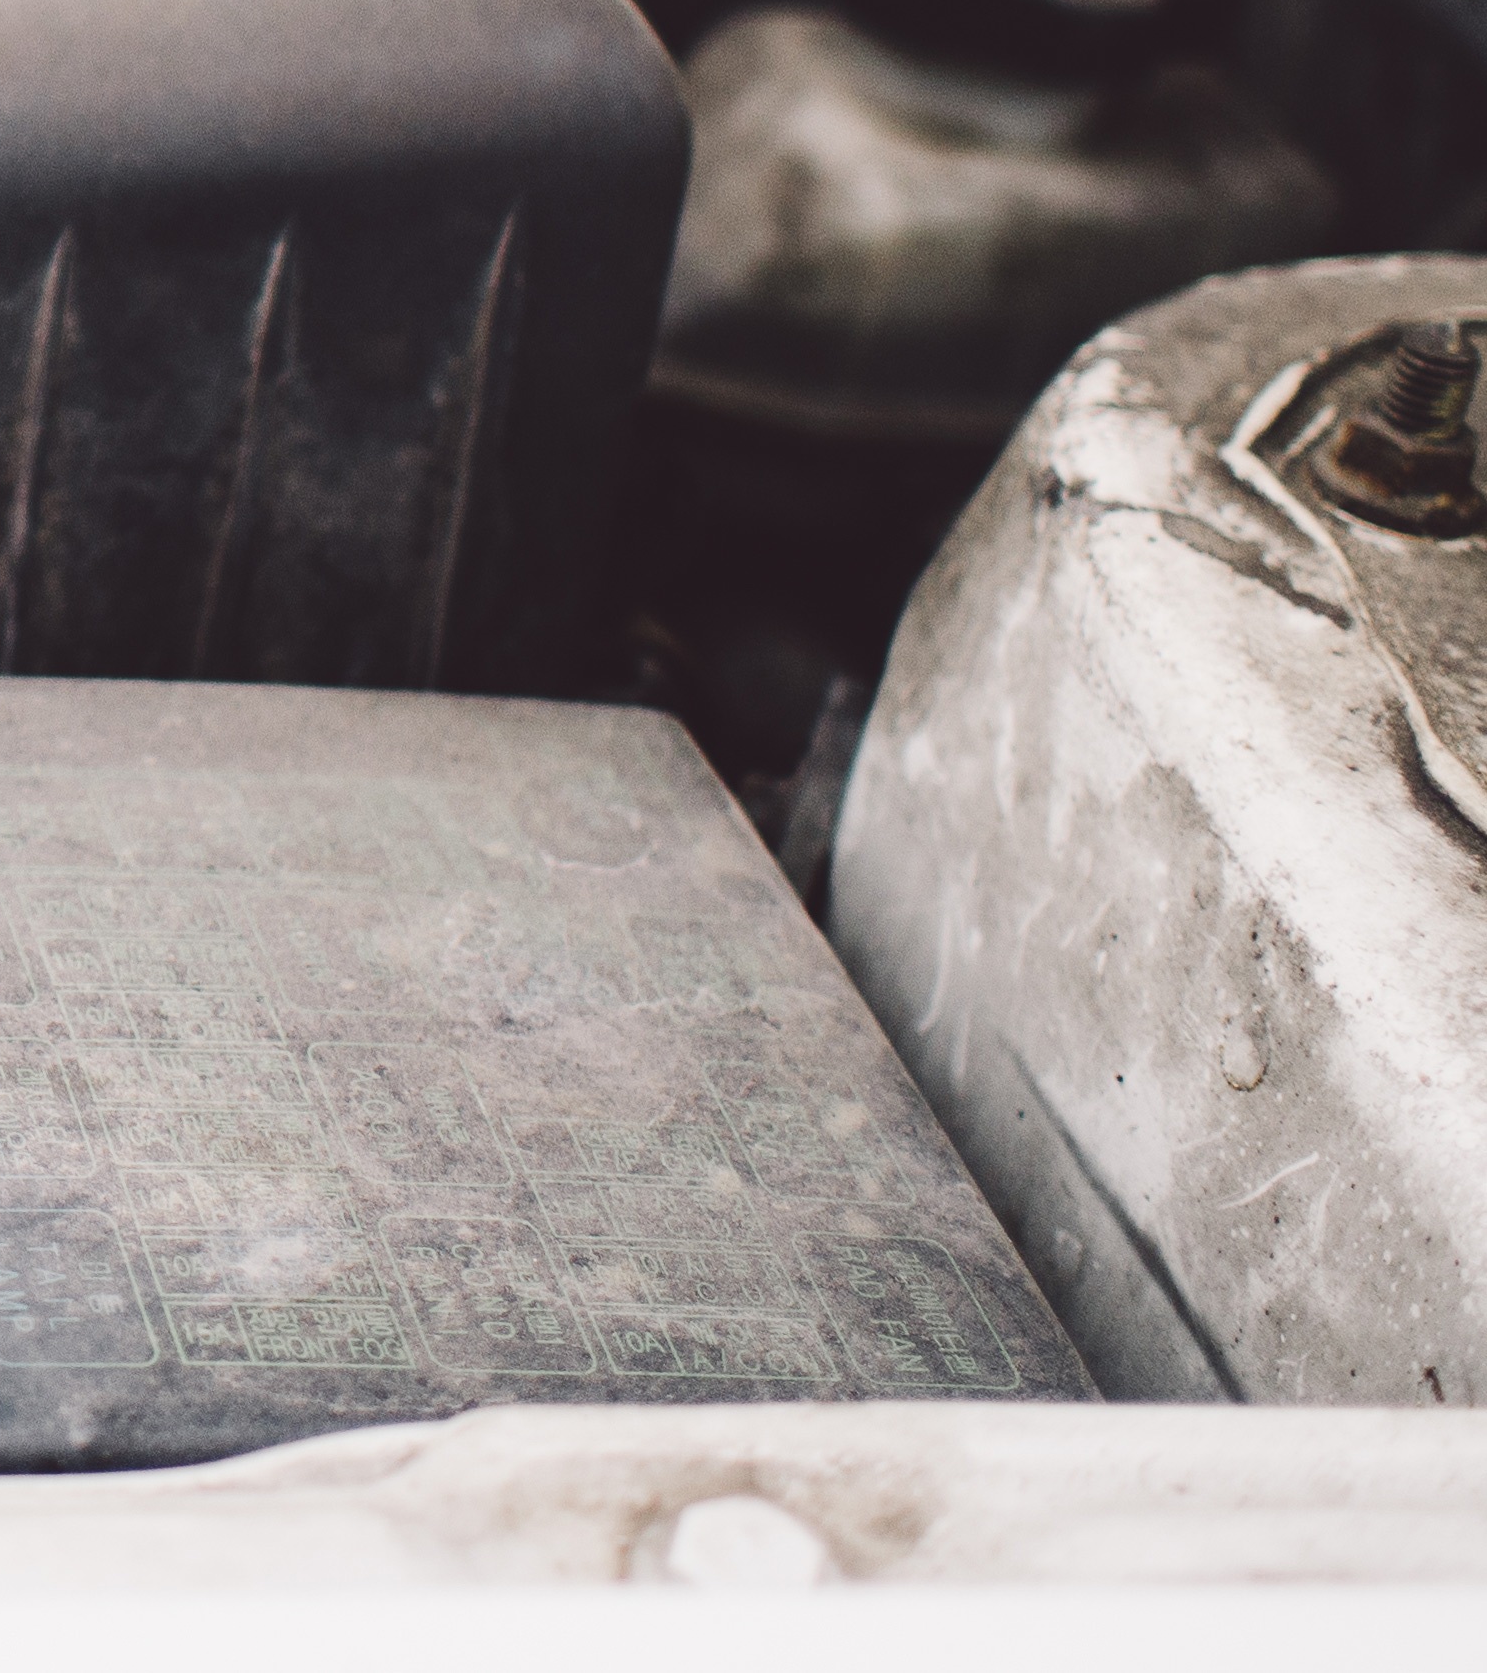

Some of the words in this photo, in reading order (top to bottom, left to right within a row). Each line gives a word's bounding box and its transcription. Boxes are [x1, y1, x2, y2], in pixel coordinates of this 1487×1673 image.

[21, 1240, 87, 1331] TAIL
[450, 1244, 519, 1340] COND
[247, 1309, 300, 1333] 전방
[837, 1246, 887, 1300] RAD
[876, 1319, 931, 1373] FAN
[181, 1320, 236, 1346] 15A
[611, 1331, 667, 1354] 10A
[254, 1336, 340, 1359] FRONT
[347, 1338, 403, 1360] FOG
